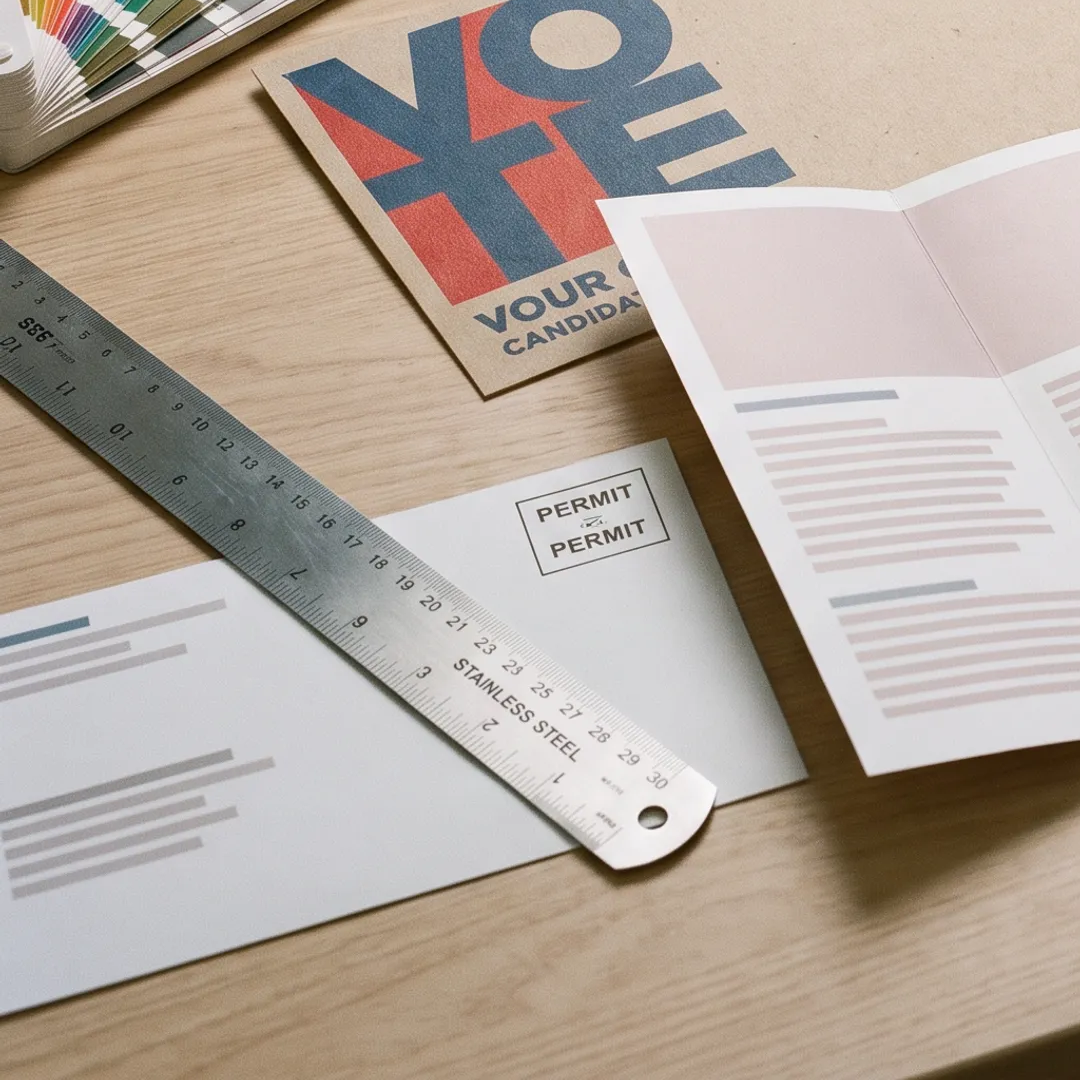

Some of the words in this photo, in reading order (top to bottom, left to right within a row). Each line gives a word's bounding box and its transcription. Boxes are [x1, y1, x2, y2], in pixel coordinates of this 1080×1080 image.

[503, 291, 642, 356] CANDIDA
[536, 483, 632, 523] PERMIT
[230, 519, 246, 531] 8
[549, 518, 646, 559] PERMIT
[78, 330, 91, 340] 5
[124, 366, 137, 375] 7
[147, 384, 160, 393] 8
[171, 402, 184, 411] 9
[191, 417, 209, 432] 10
[216, 437, 235, 452] 12
[240, 456, 259, 470] 13
[291, 495, 311, 510] 15
[316, 514, 337, 529] 16
[343, 534, 363, 549] 17
[369, 555, 389, 570] 18
[396, 575, 415, 591] 19
[419, 595, 442, 612] 20
[446, 615, 468, 632] 21
[473, 637, 497, 655] 23
[530, 681, 554, 699] 25
[617, 748, 641, 766] 29
[646, 771, 669, 790] 30
[289, 568, 308, 581] 7
[416, 666, 432, 679] 3
[453, 658, 535, 723] STAINLESS
[532, 720, 583, 763] STEEL
[482, 718, 499, 732] 2
